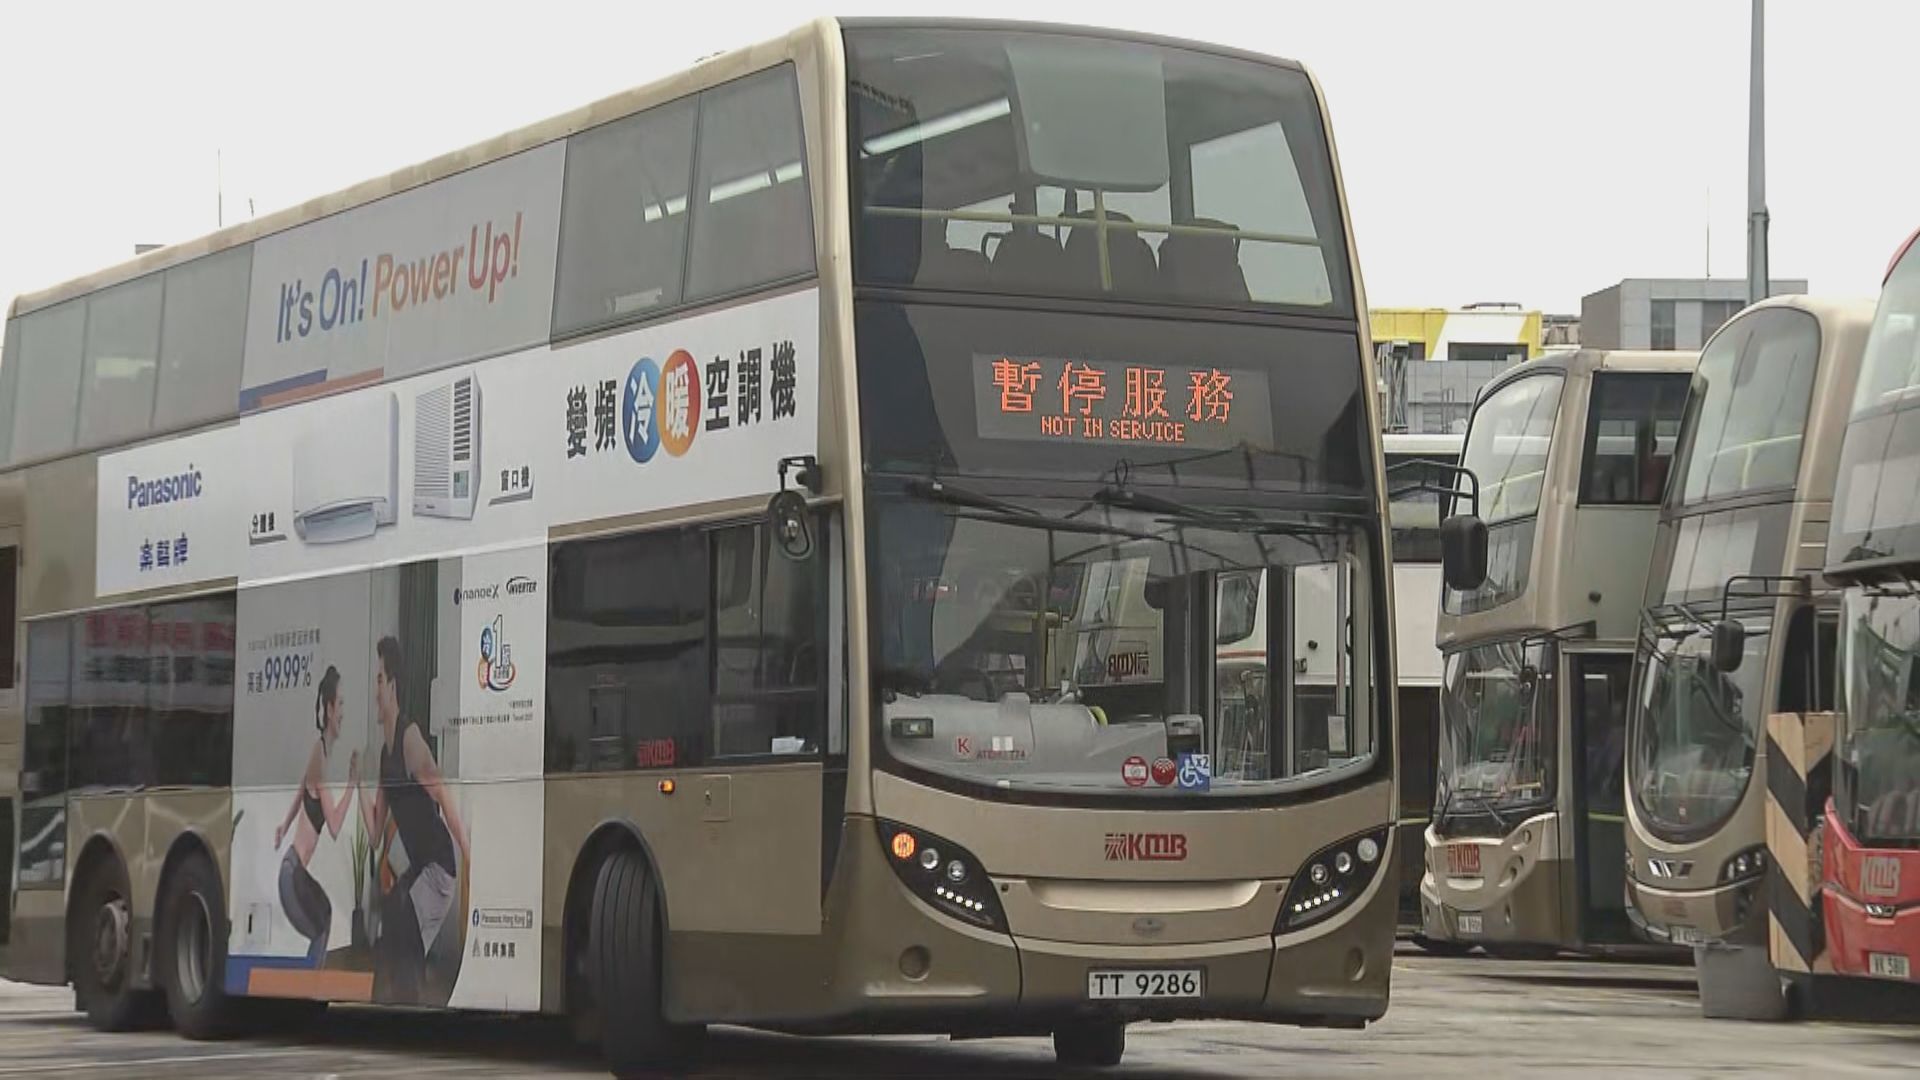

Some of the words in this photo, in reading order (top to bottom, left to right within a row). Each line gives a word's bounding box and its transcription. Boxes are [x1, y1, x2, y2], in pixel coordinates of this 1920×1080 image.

[277, 279, 314, 343] It's
[319, 258, 368, 331] On!
[372, 246, 465, 318] Power
[468, 211, 523, 304] Up!
[991, 357, 1234, 424] 暫停服務
[1041, 415, 1076, 436] NOT
[1083, 417, 1104, 438] IN
[1109, 419, 1186, 443] SERVICE
[128, 463, 203, 509] Panasonic
[957, 738, 970, 753] K
[1128, 834, 1187, 861] KMB
[1457, 843, 1481, 873] KMB
[1860, 855, 1901, 898] KMB
[1095, 974, 1124, 995] TT
[1136, 973, 1196, 996] 9286
